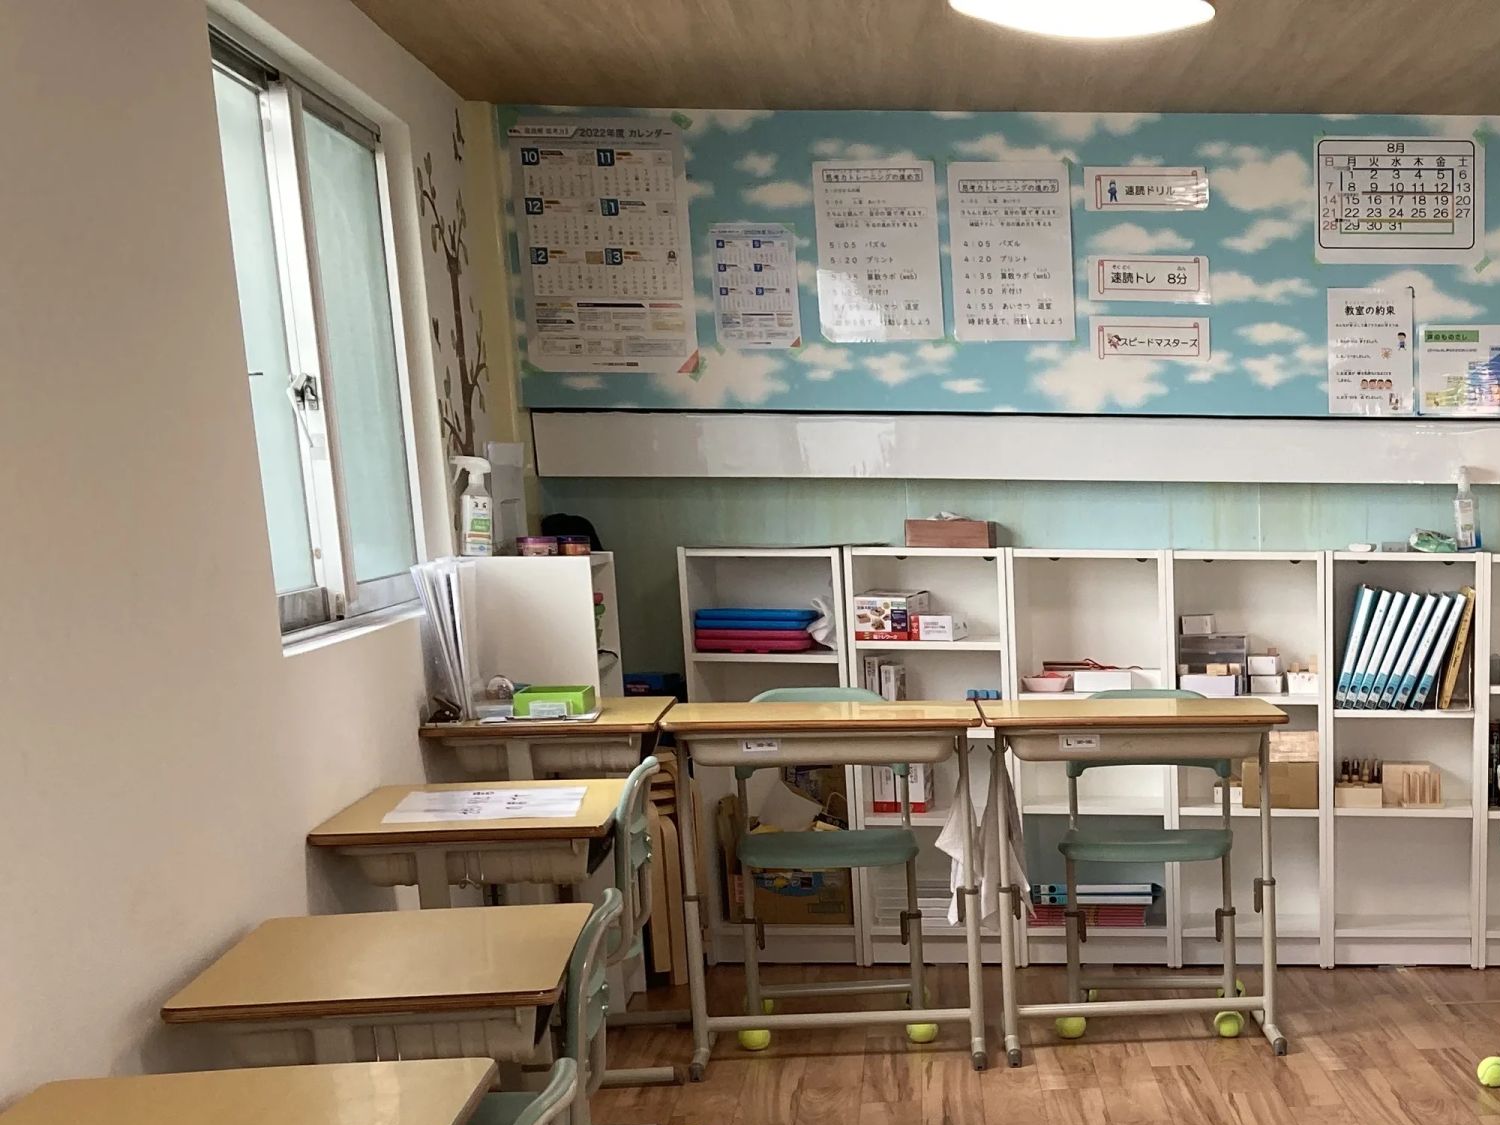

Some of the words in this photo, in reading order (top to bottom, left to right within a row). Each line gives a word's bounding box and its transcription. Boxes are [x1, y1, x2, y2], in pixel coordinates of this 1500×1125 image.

[579, 129, 624, 138] 2022年度
[629, 129, 672, 138] カレンダー
[1387, 143, 1404, 153] 8月
[523, 151, 537, 163] 10
[599, 152, 612, 164] 11
[1325, 157, 1333, 166] 日
[1348, 157, 1356, 166] 月
[1370, 157, 1379, 166] 火
[1391, 157, 1401, 166] 水
[1414, 157, 1423, 166] 木
[1436, 157, 1445, 166] 金
[1459, 157, 1469, 166] 土
[1349, 170, 1353, 179] 1
[1371, 170, 1378, 179] 2
[1392, 170, 1400, 179] 3
[1415, 170, 1422, 179] 4
[1437, 170, 1445, 179] 5
[1460, 170, 1467, 179] 6
[1125, 185, 1176, 196] 速読ドリル
[1326, 182, 1333, 192] 7
[1348, 182, 1356, 192] 8
[1370, 182, 1378, 192] 9
[1390, 182, 1404, 192] 10
[1412, 182, 1424, 192] 11
[1435, 182, 1448, 192] 12
[1456, 182, 1470, 192] 13
[1323, 195, 1336, 205] 14
[1346, 195, 1359, 205] 15
[1368, 195, 1382, 205] 16
[1390, 195, 1403, 205] 17
[1412, 195, 1426, 205] 18
[1435, 195, 1448, 205] 19
[1456, 195, 1470, 205] 20
[527, 201, 541, 212] 12
[610, 202, 616, 214] 1
[1323, 208, 1336, 218] 21
[1344, 208, 1359, 218] 22
[1366, 208, 1382, 218] 23
[1388, 208, 1403, 218] 24
[1411, 208, 1426, 218] 25
[1433, 208, 1448, 218] 26
[1456, 208, 1470, 218] 27
[1323, 221, 1337, 230] 28
[1344, 221, 1359, 230] 29
[1366, 221, 1382, 230] 30
[1388, 221, 1402, 230] 31
[537, 251, 547, 262] 2
[613, 251, 621, 262] 3
[866, 256, 894, 264] プリント
[1111, 272, 1156, 284] 速読トレ
[1167, 273, 1187, 285] 8分
[1345, 306, 1396, 316] 教室の約束
[1120, 337, 1198, 348] スピードマスターズ
[1066, 738, 1072, 746] L
